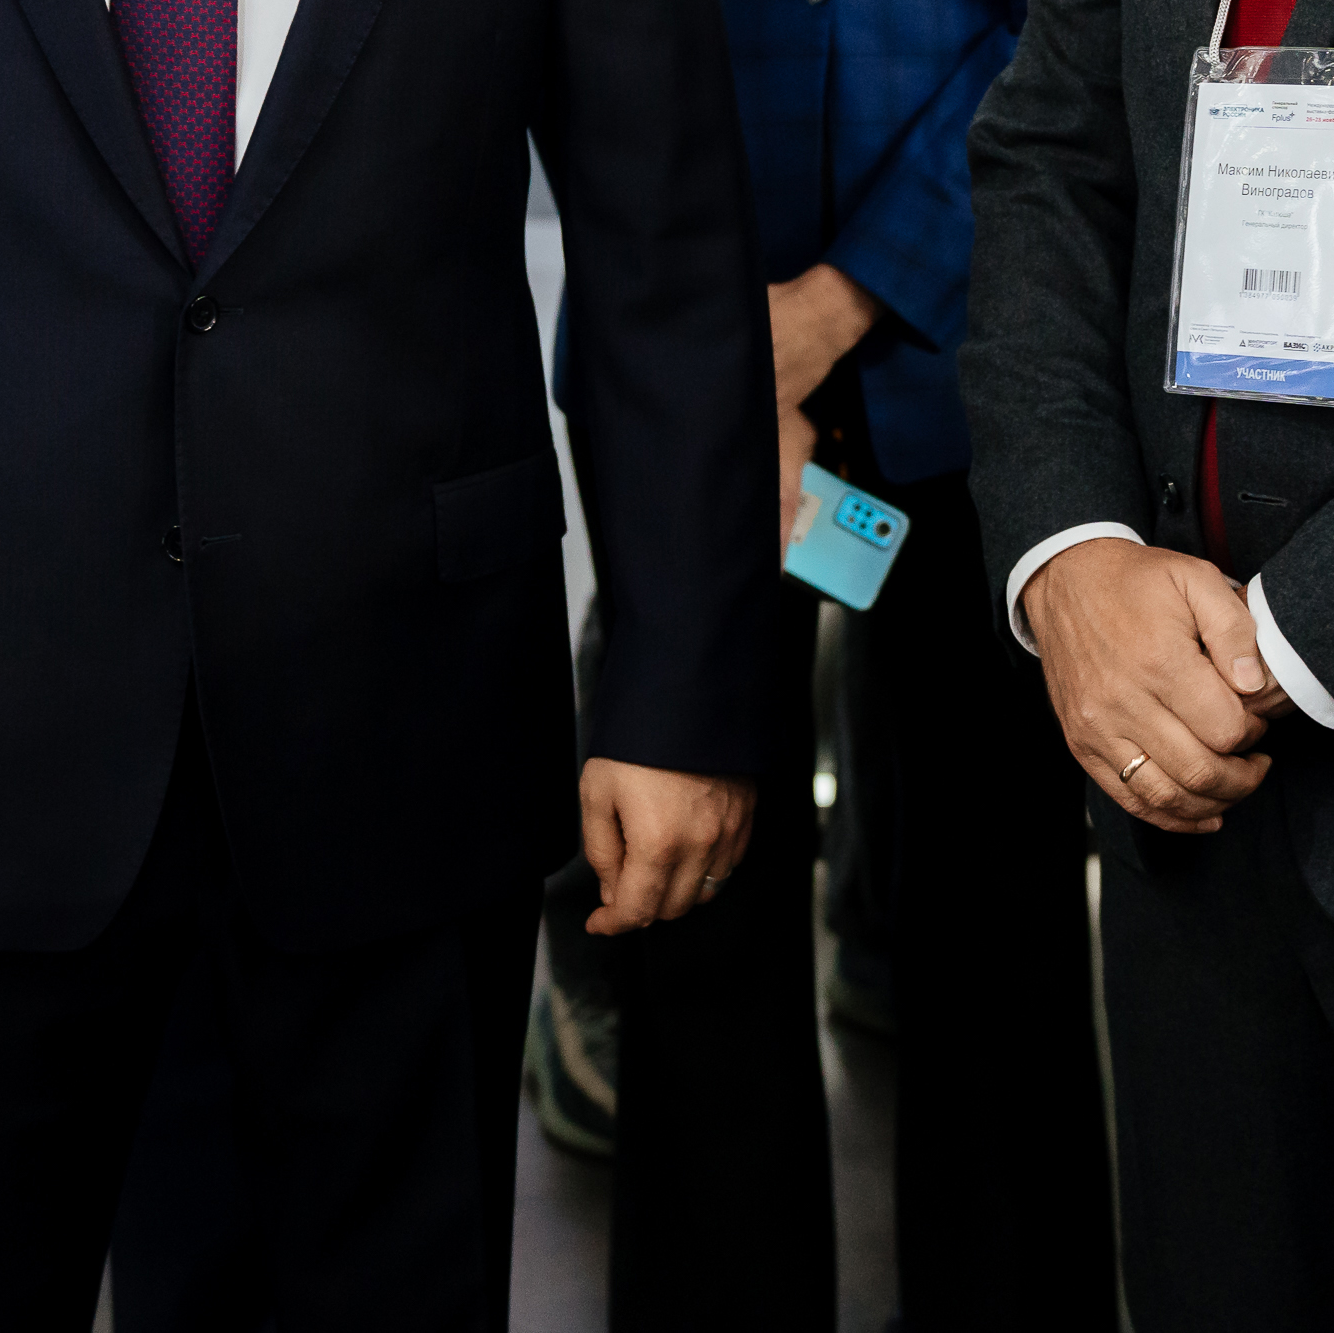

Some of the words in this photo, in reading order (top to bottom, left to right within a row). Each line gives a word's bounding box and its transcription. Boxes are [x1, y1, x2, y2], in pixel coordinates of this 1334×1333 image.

[1217, 162, 1265, 177] Максим
[1241, 183, 1315, 201] Виноградов
[1241, 219, 1280, 229] Генеральный
[1280, 222, 1308, 231] директор
[1236, 366, 1286, 383] УЧАСТНИК
